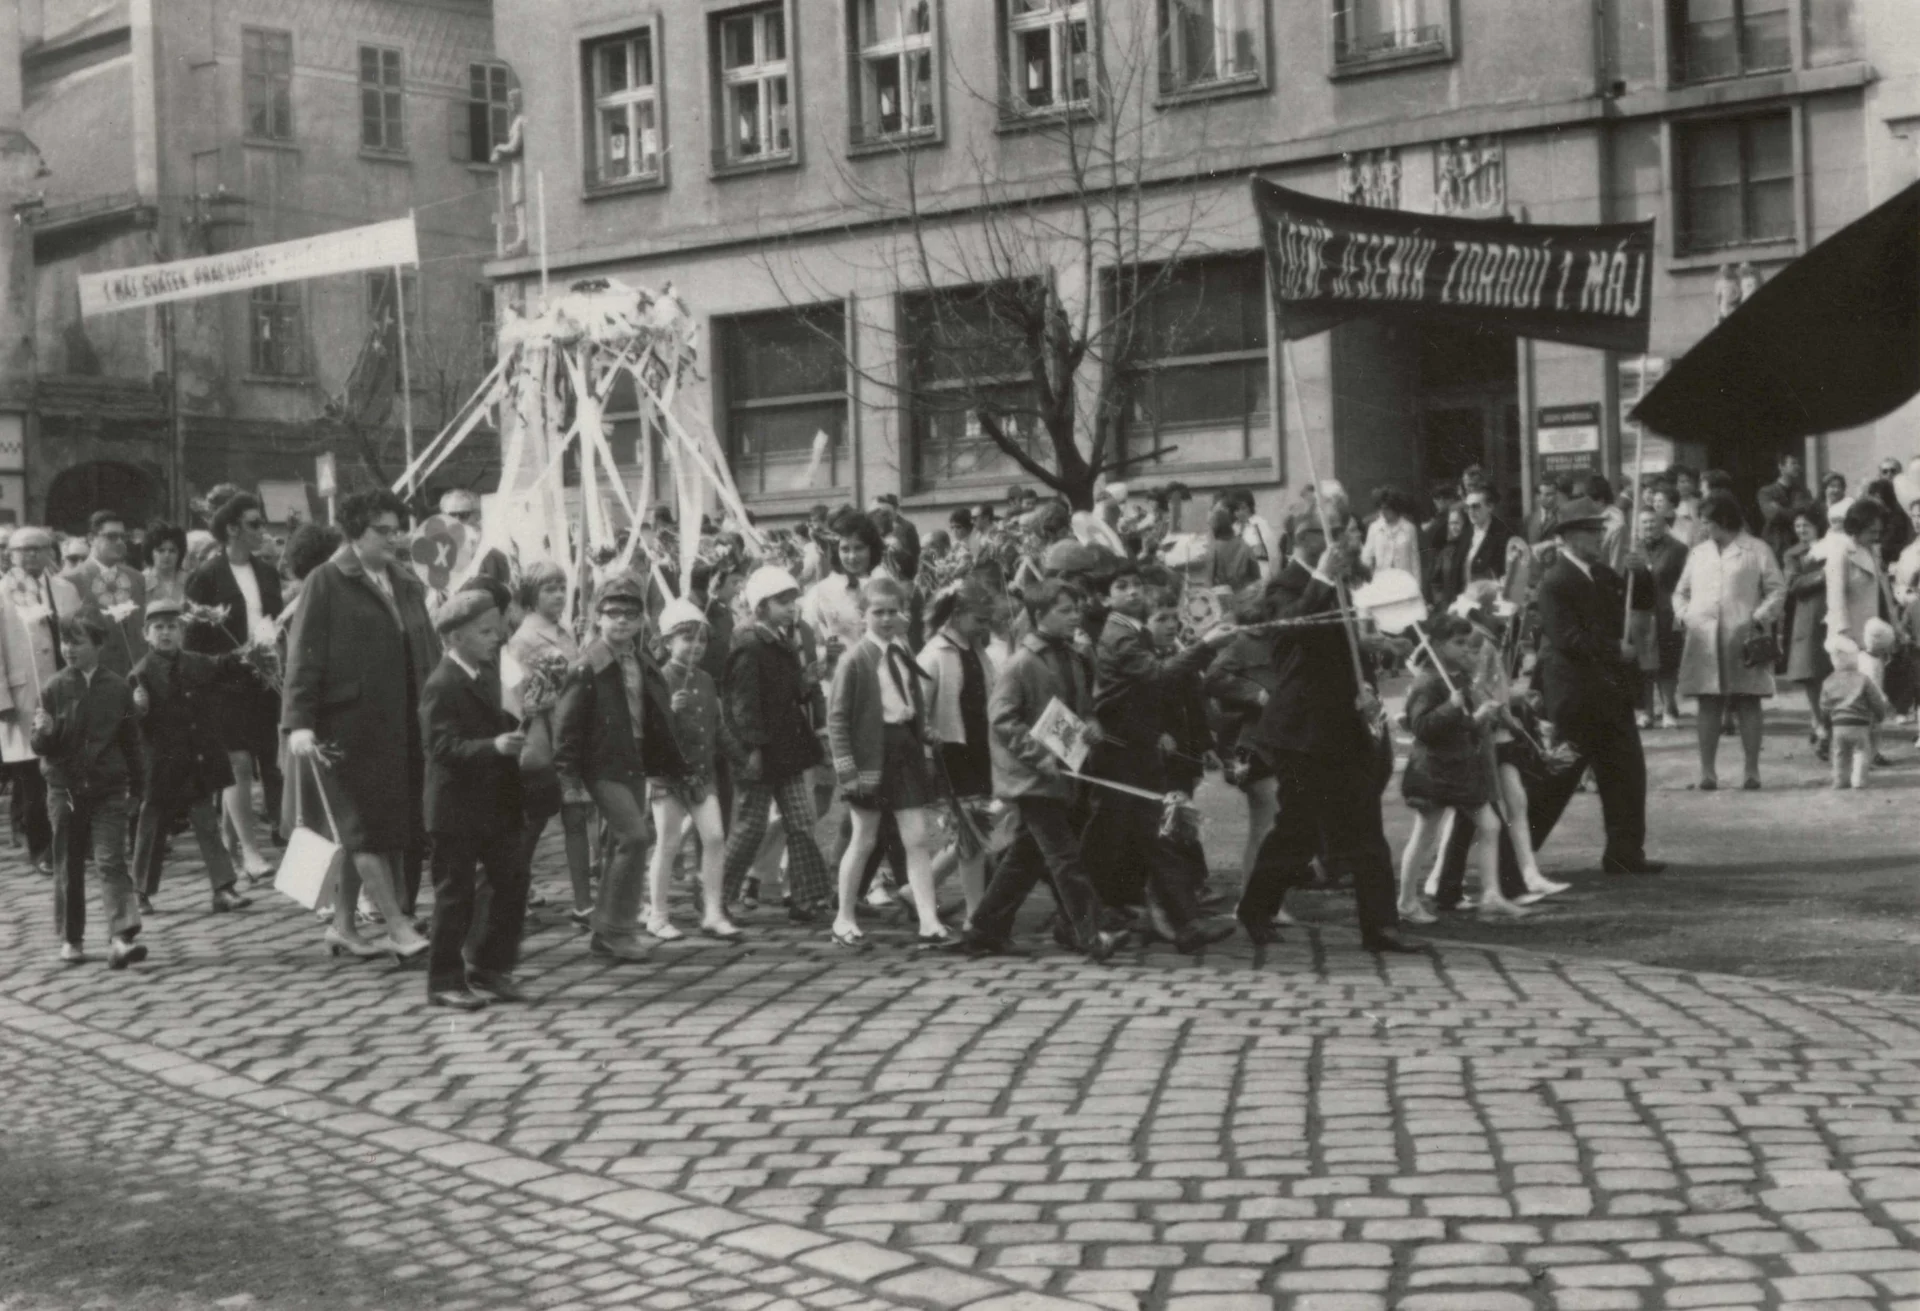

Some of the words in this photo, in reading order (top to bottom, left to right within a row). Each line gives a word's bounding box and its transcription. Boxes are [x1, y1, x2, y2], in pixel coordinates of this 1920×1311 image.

[1332, 227, 1437, 300] JESENÍK
[1440, 237, 1554, 310] ZDRAVÍ
[1580, 239, 1645, 317] MÁJ
